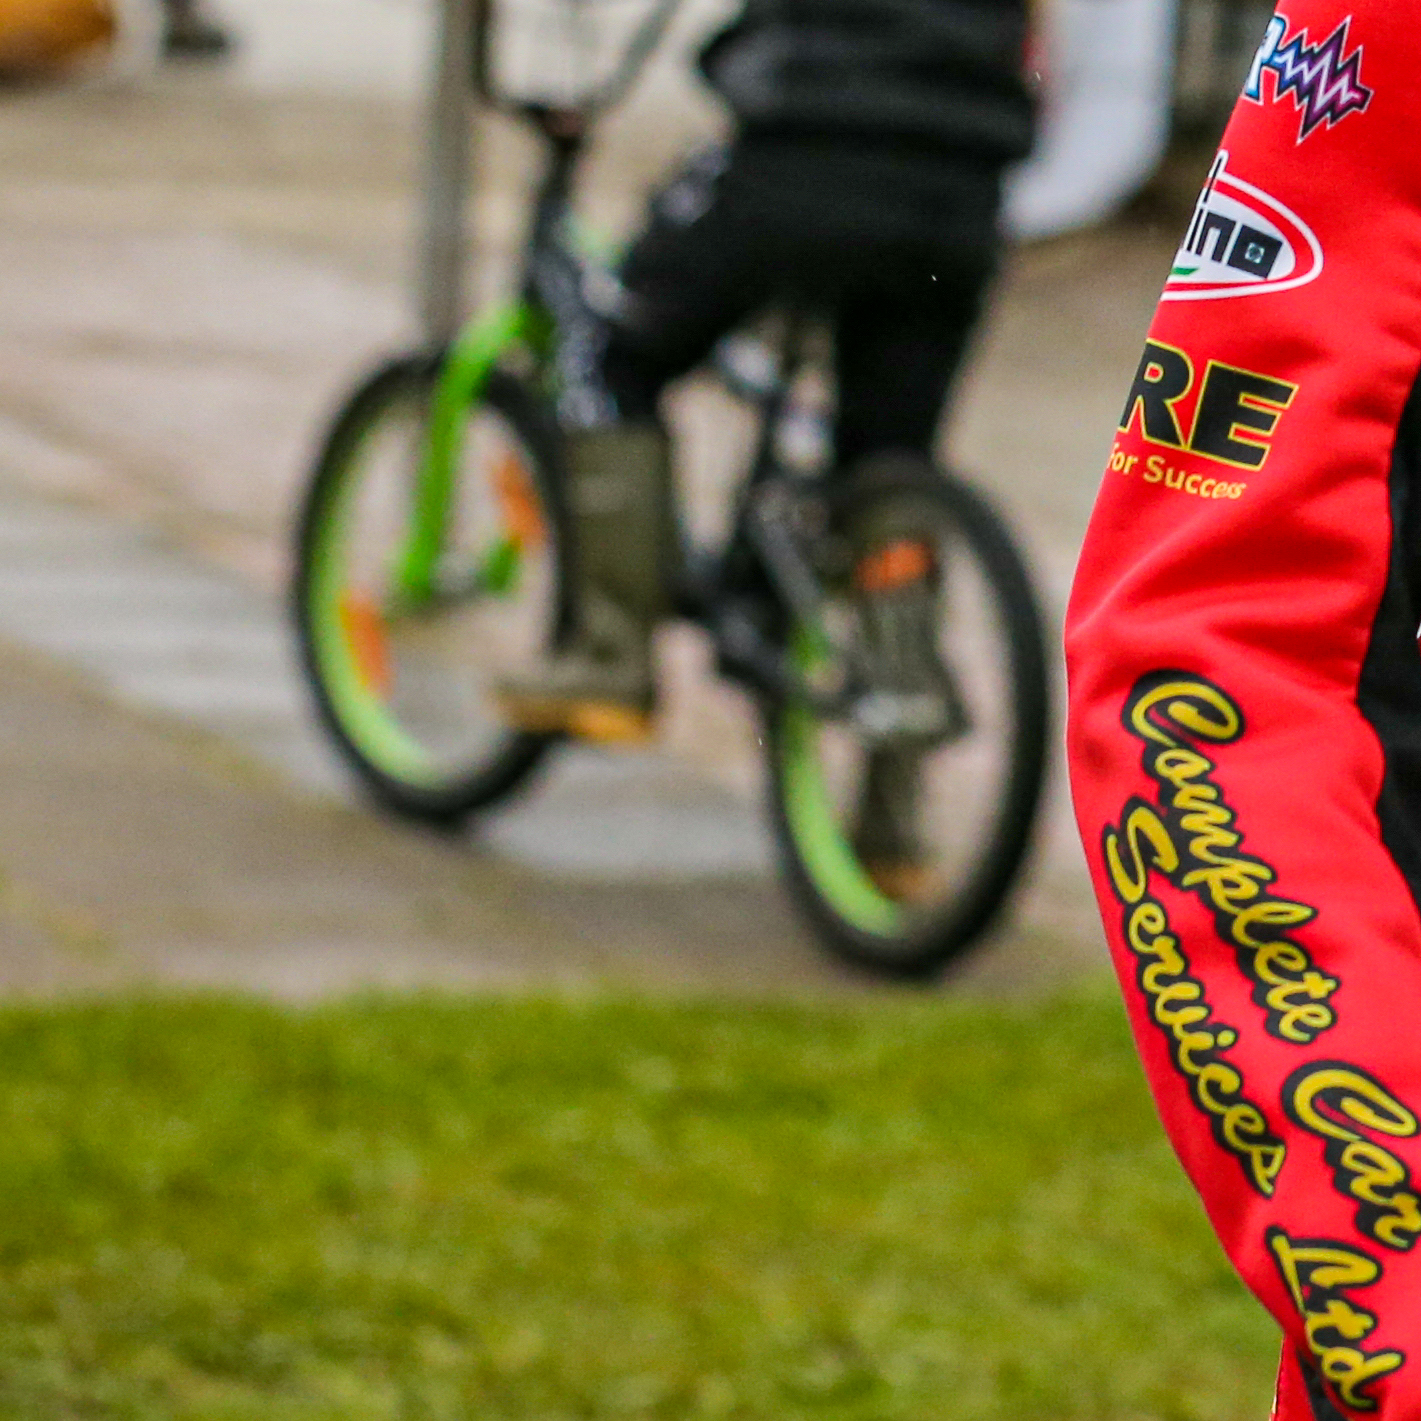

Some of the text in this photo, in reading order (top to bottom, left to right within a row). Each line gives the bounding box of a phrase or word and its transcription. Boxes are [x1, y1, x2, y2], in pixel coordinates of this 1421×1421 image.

[1130, 679, 1338, 1043] Complete
[1106, 805, 1405, 1409] Services Ltd
